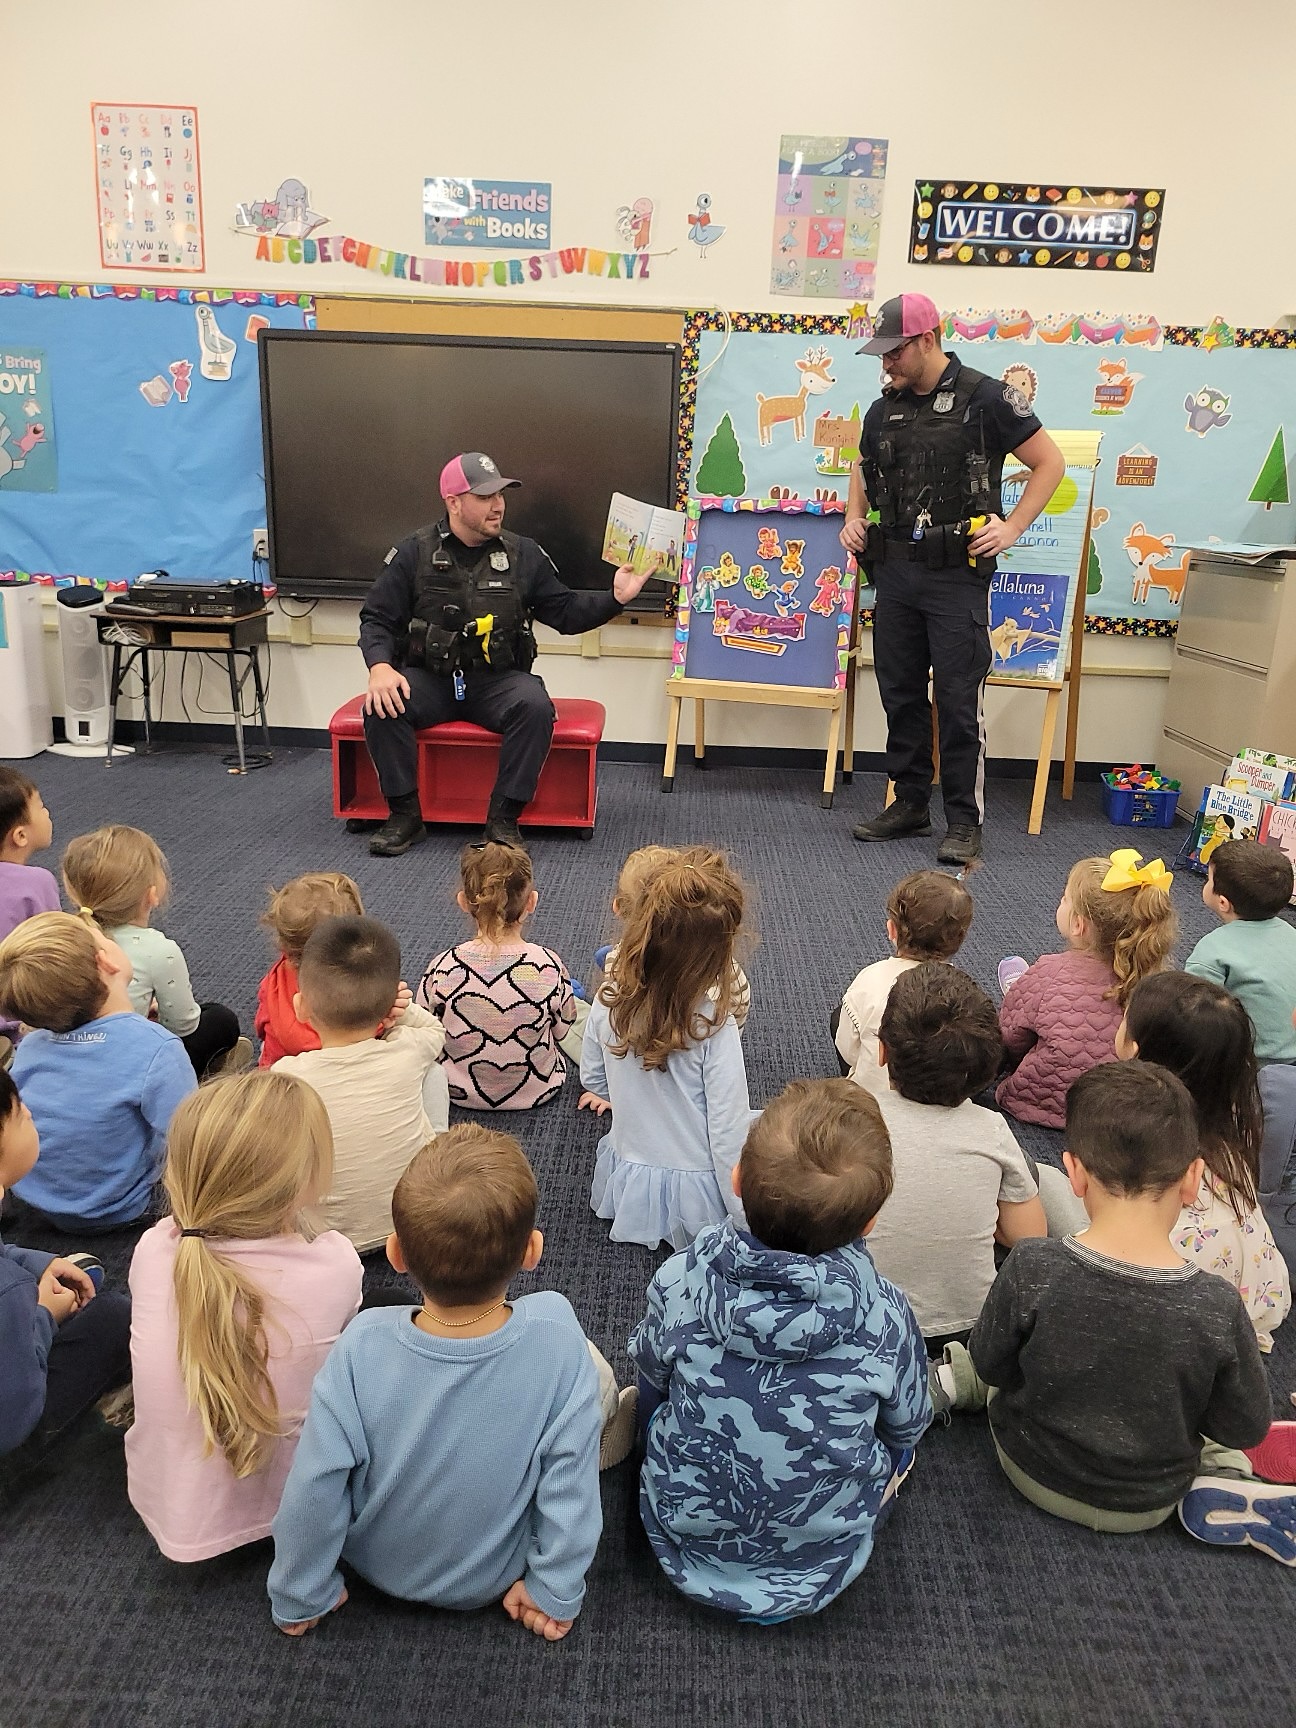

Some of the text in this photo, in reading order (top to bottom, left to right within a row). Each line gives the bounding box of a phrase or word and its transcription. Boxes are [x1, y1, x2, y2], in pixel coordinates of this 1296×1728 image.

[182, 115, 193, 126] Ee
[120, 146, 132, 161] Gg
[140, 146, 153, 158] Hh
[164, 147, 173, 158] Ii
[184, 182, 196, 193] Oo
[469, 188, 549, 213] Friends
[166, 210, 176, 221] Ss
[185, 210, 197, 222] Tt
[464, 215, 549, 240] with Books
[943, 208, 1130, 244] WELCOME!
[137, 240, 155, 250] Ww
[158, 240, 169, 251] Xx
[187, 241, 198, 253] Zz
[5, 355, 42, 375] Bring
[1123, 458, 1153, 466] LEARNING
[1237, 762, 1273, 780] Scooper and
[1250, 776, 1276, 792] Dumper
[1217, 791, 1253, 810] The Little
[1211, 799, 1254, 822] Blue Bridge
